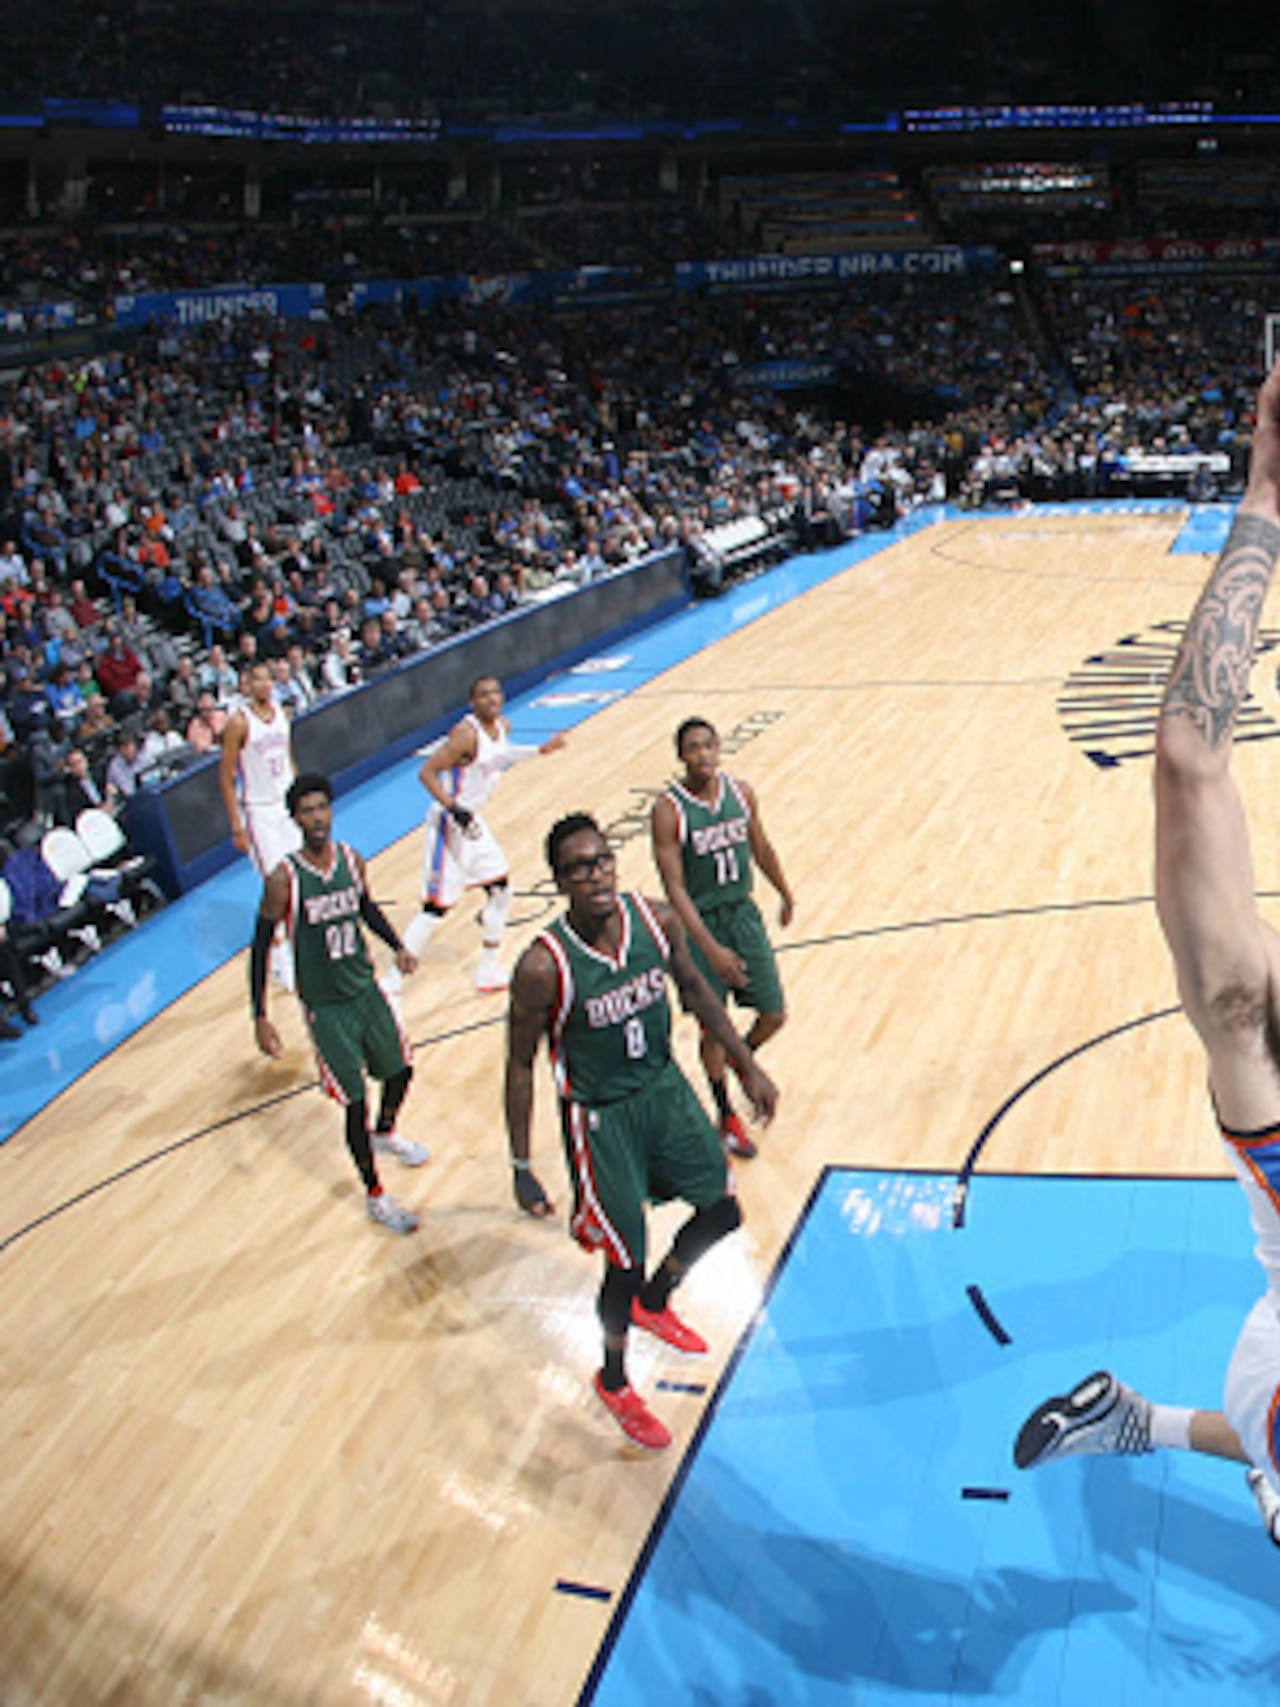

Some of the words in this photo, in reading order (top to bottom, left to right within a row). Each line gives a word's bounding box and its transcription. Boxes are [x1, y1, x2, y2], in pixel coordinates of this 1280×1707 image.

[175, 291, 278, 324] THUNDER
[692, 817, 747, 855] BUCKS
[714, 849, 738, 885] 11
[304, 887, 360, 924] BUCKS
[587, 969, 665, 1027] BUCKS
